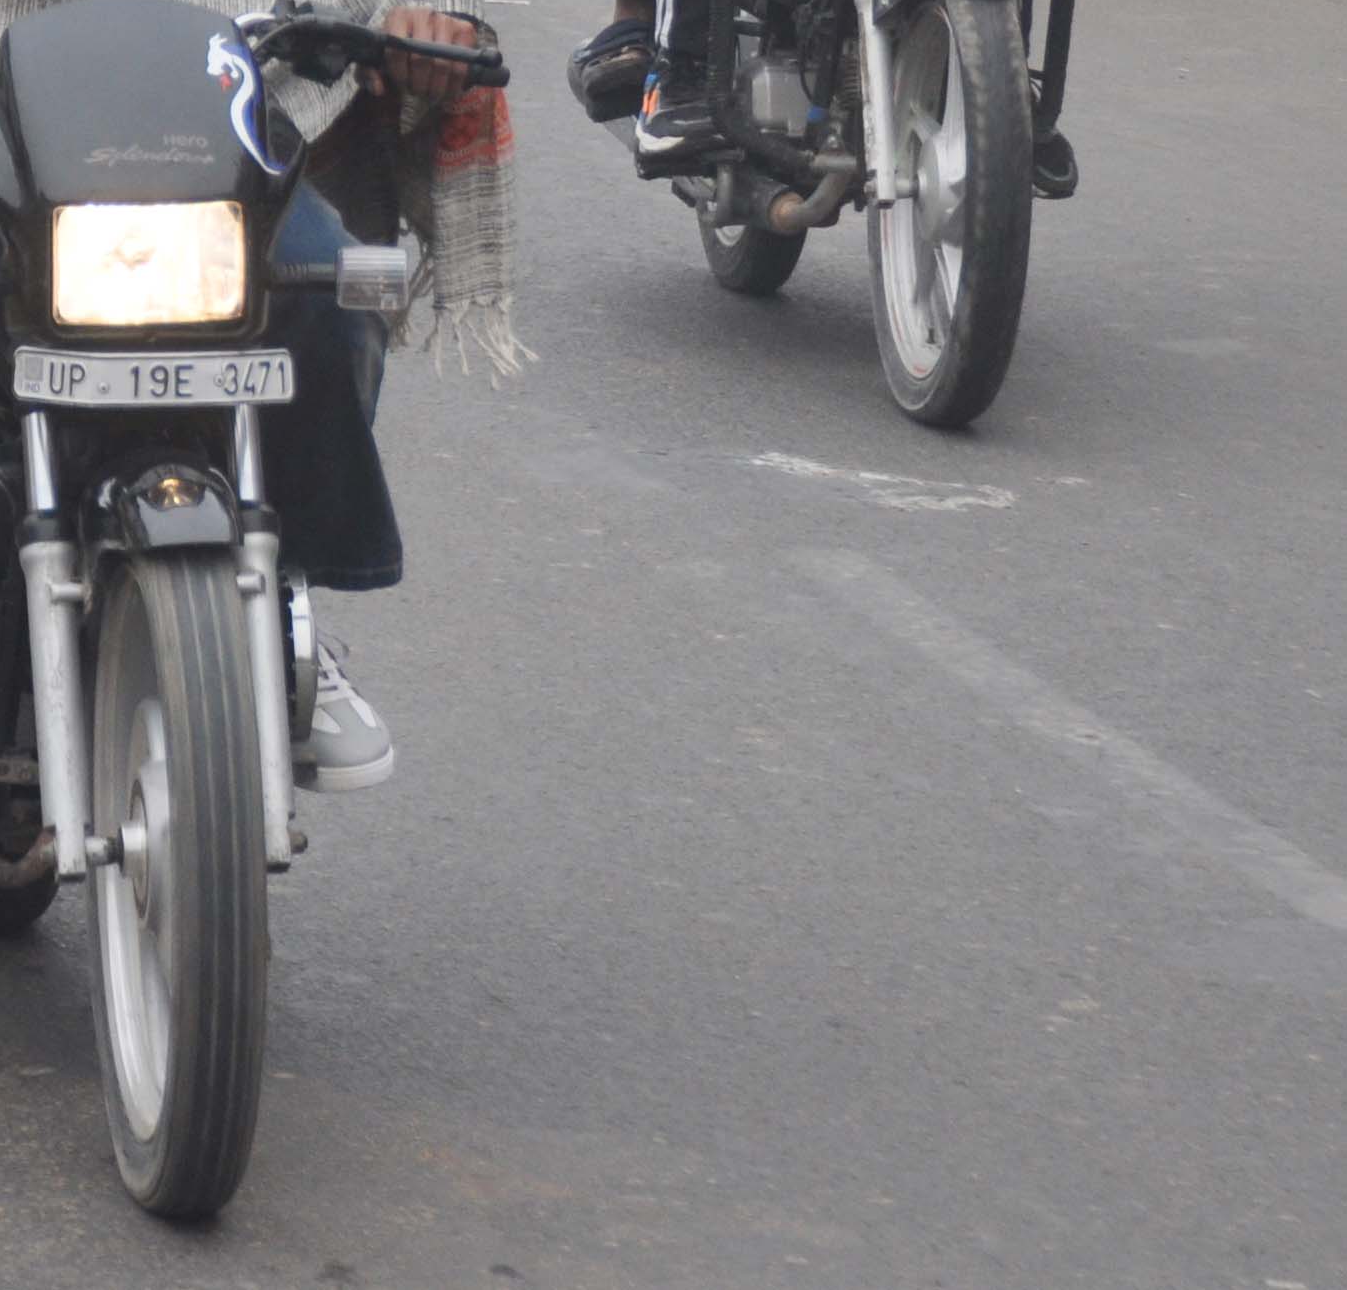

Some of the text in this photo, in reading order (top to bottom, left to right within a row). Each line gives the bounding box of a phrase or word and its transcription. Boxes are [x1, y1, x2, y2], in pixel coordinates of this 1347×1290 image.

[49, 360, 286, 398] UP 19E 3471
